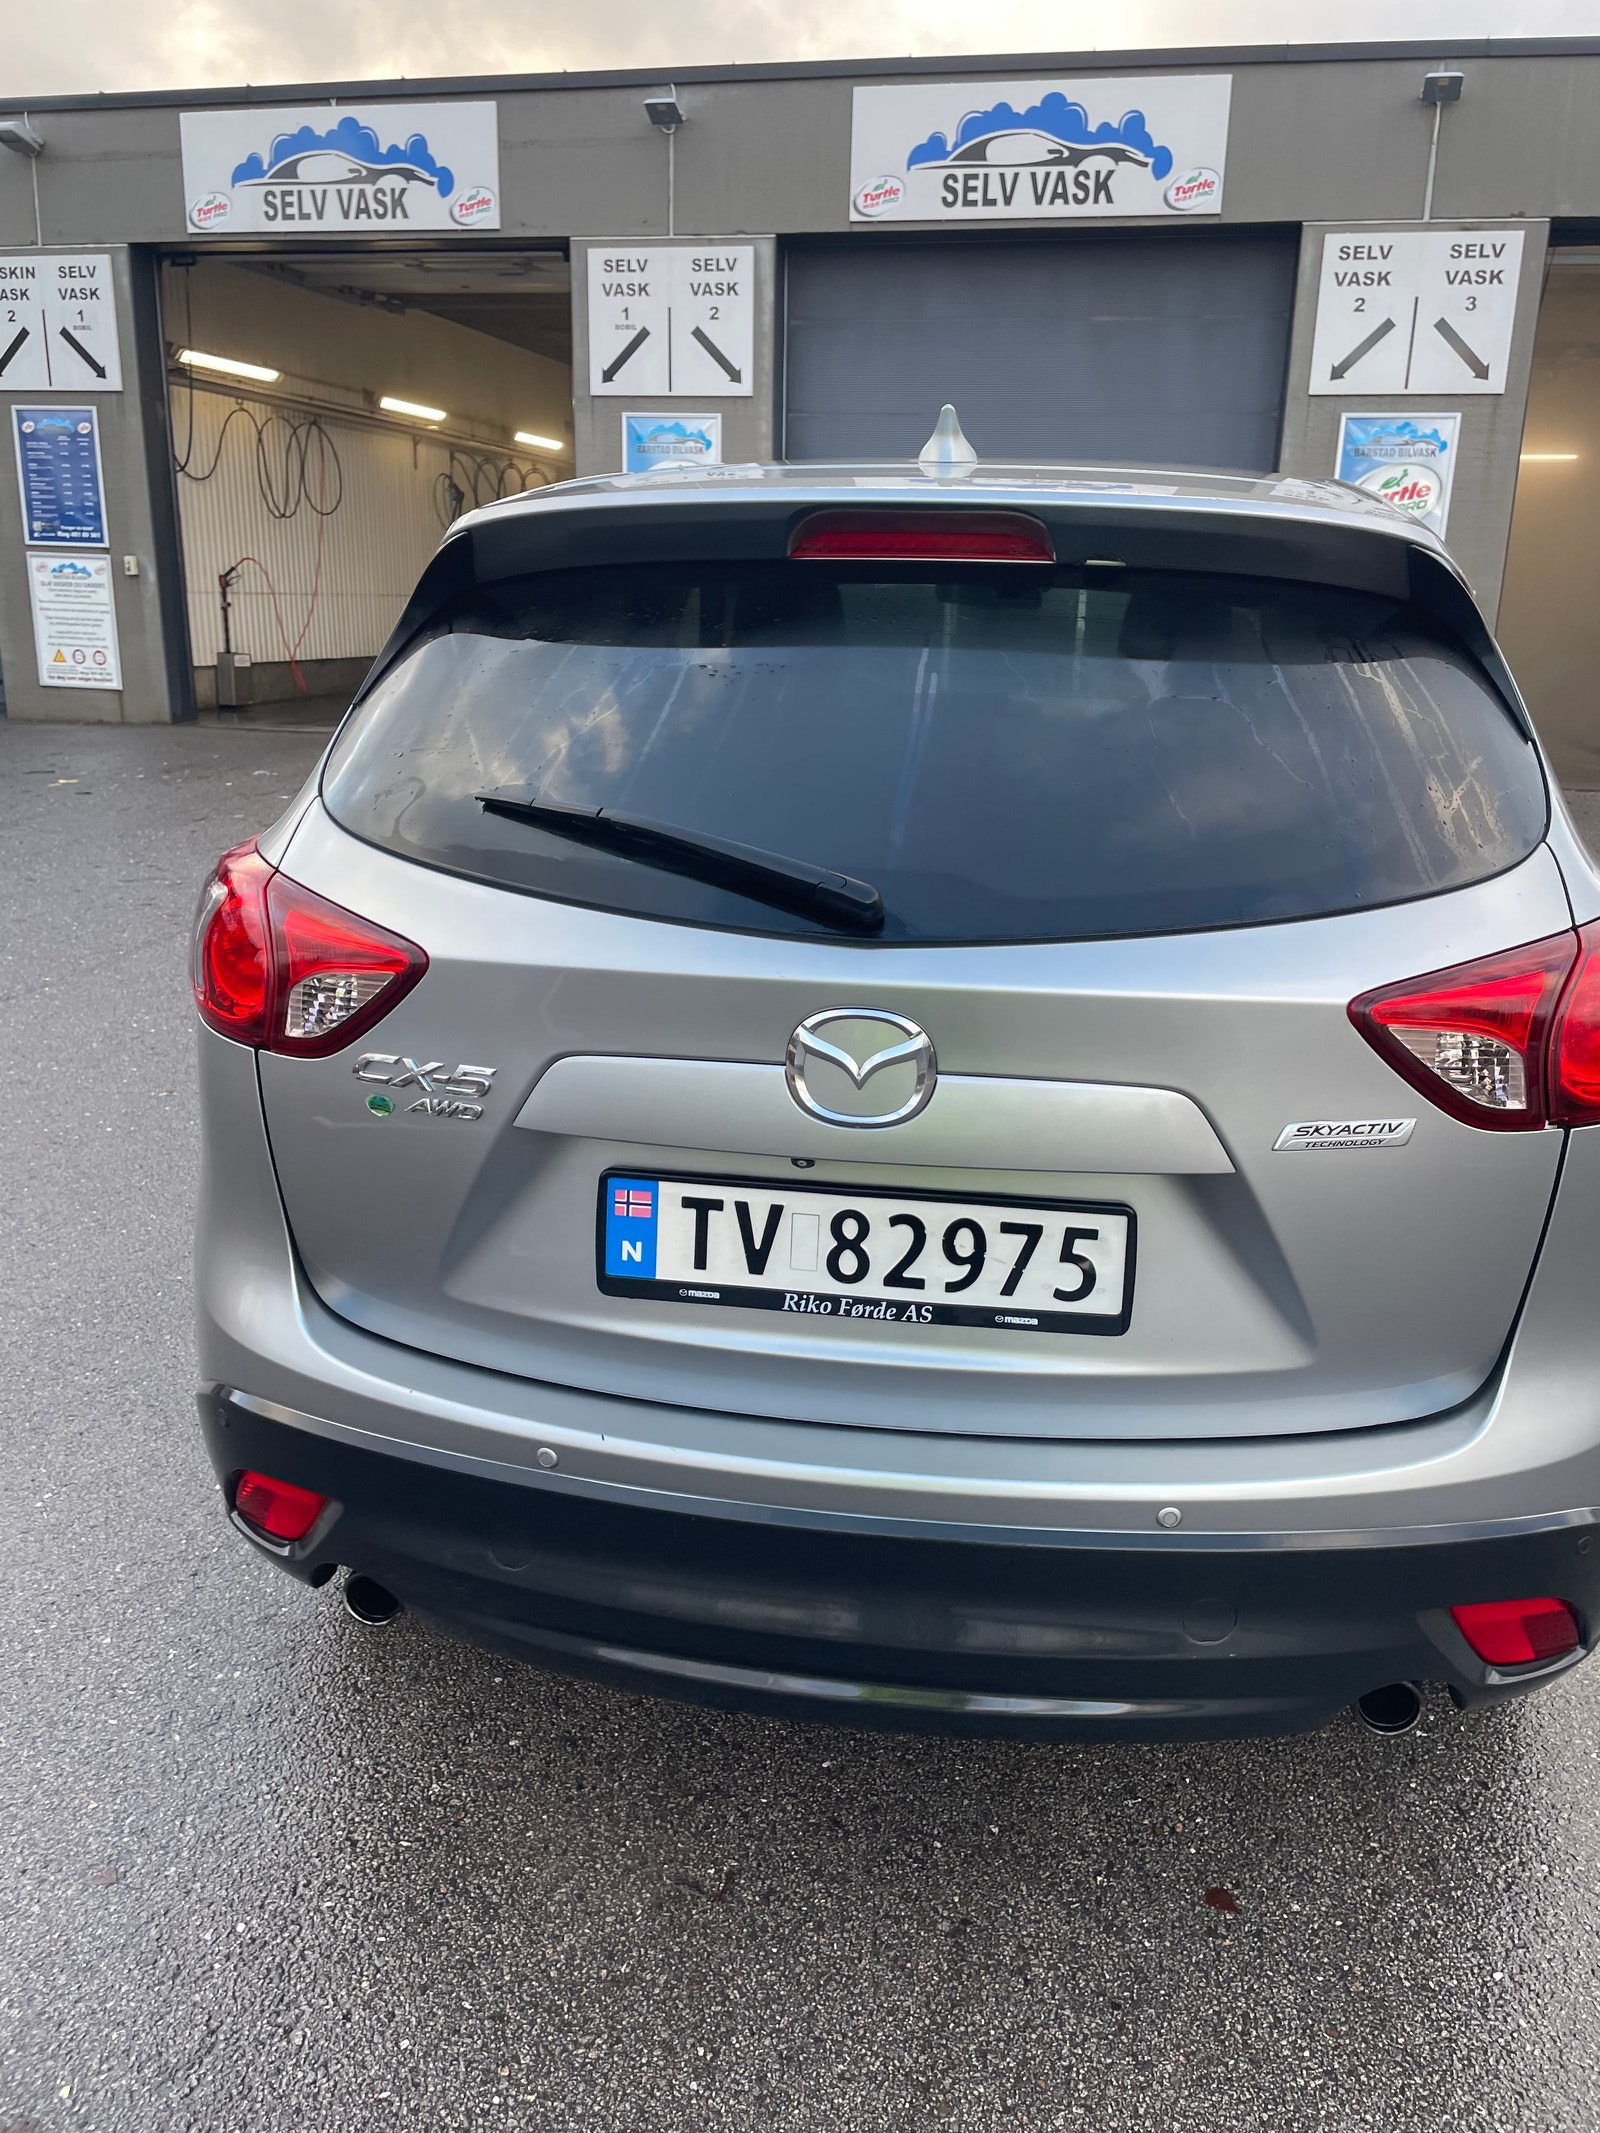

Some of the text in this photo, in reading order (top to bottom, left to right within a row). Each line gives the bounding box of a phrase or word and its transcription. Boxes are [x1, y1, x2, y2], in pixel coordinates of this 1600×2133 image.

[862, 185, 901, 204] Turtle
[941, 169, 1115, 208] SELV VASK
[1174, 178, 1216, 197] Turtle
[263, 187, 409, 221] SELV VASK
[1338, 245, 1394, 261] SELV
[1449, 243, 1506, 259] SELV
[58, 265, 96, 279] SELV
[603, 258, 649, 273] SELV
[691, 257, 737, 272] SELV
[0, 266, 36, 280] SKIN
[1334, 271, 1392, 287] VASK
[1445, 269, 1505, 286] VASK
[58, 287, 101, 301] VASK
[602, 282, 651, 297] VASK
[690, 281, 739, 297] VASK
[1353, 297, 1366, 313] 2
[1464, 296, 1477, 311] 3
[7, 309, 17, 323] 2
[77, 309, 85, 322] 1
[621, 306, 630, 321] 1
[708, 306, 720, 321] 2
[1353, 447, 1437, 458] BARSTAD BILVASK
[1382, 481, 1431, 502] rtle
[352, 1052, 498, 1098] CX-5
[404, 1098, 484, 1121] AWD
[1292, 1121, 1404, 1138] SKYACTIV
[1304, 1138, 1386, 1148] TECHNOLOGY
[621, 1240, 642, 1263] N
[681, 1196, 1100, 1302] TV 82975
[687, 1290, 721, 1299] mazda
[781, 1292, 933, 1324] Riko Førde AS
[1004, 1316, 1039, 1326] mazda
